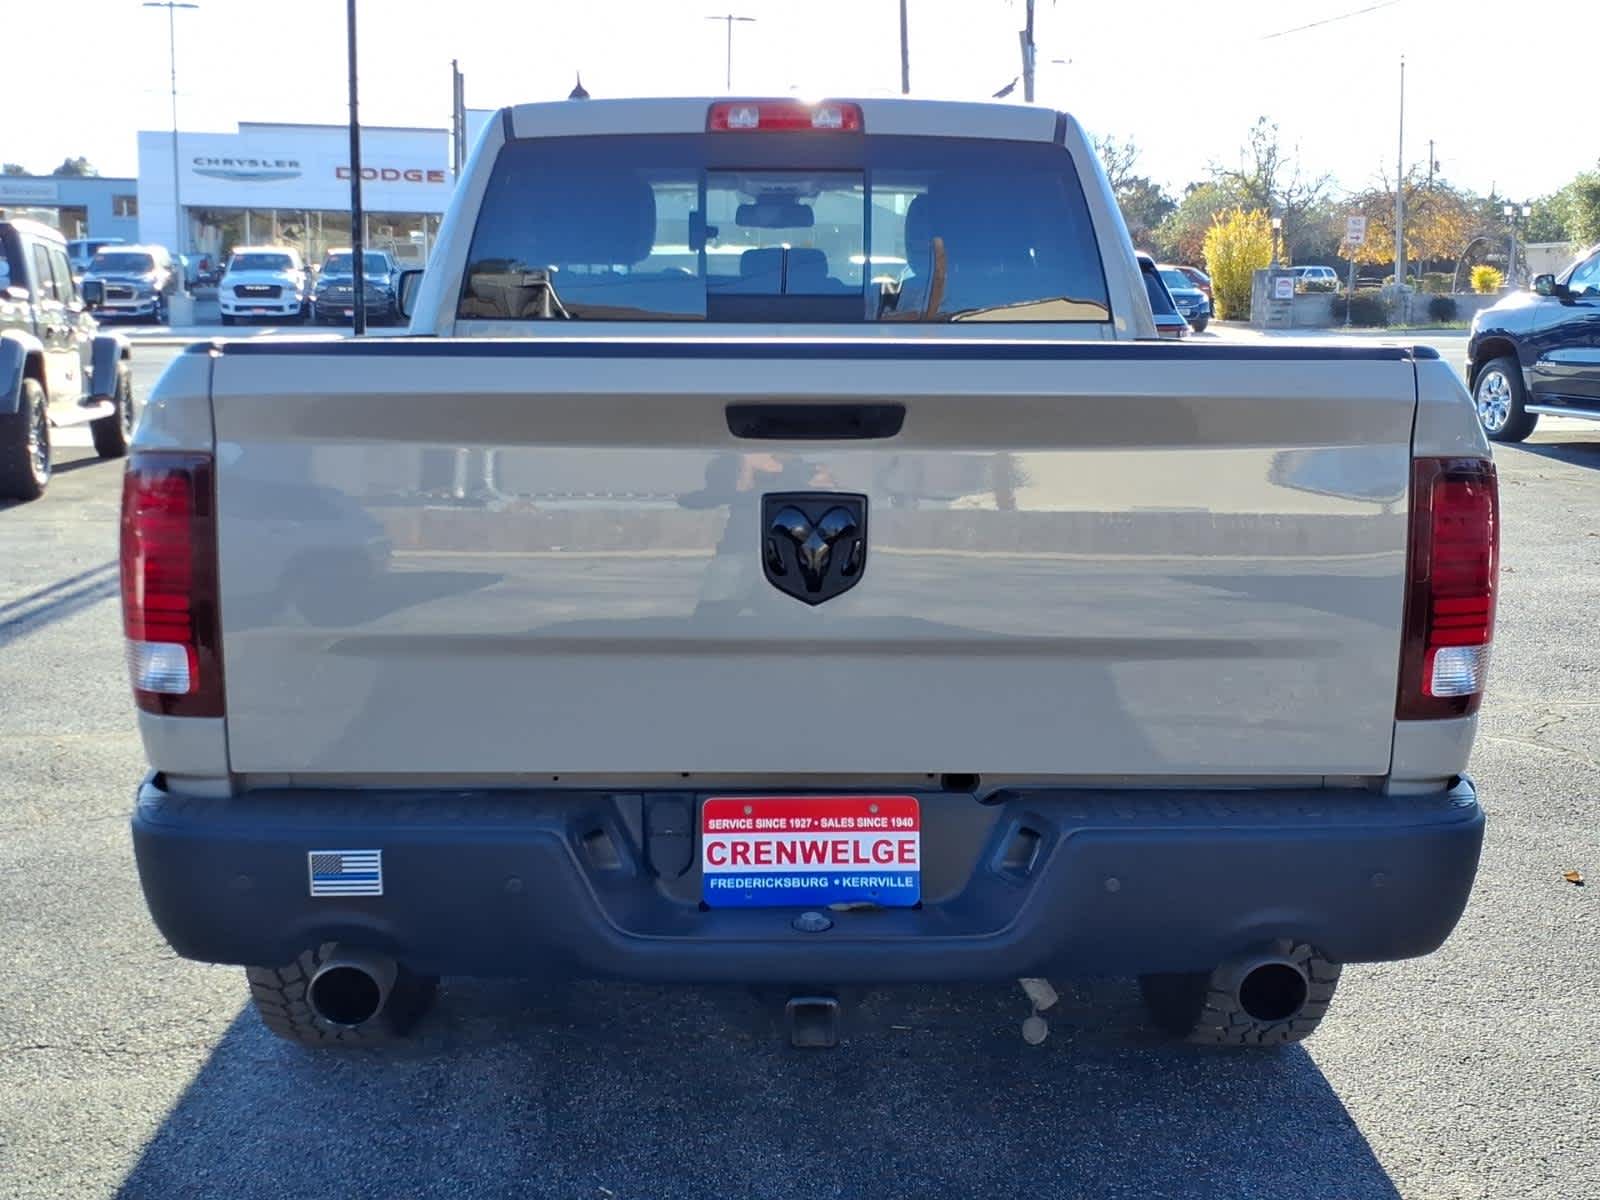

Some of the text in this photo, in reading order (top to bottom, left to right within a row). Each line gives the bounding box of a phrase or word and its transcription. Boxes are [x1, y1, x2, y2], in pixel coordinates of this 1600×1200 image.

[193, 158, 299, 168] CHRYSLER
[335, 167, 445, 182] DODGE
[708, 816, 914, 830] SERVICE SINCE 1927 SALES SINCE 1940
[706, 839, 917, 866] CRENWELGE
[710, 876, 914, 889] FREDERICKSBURG KERRVILLE
